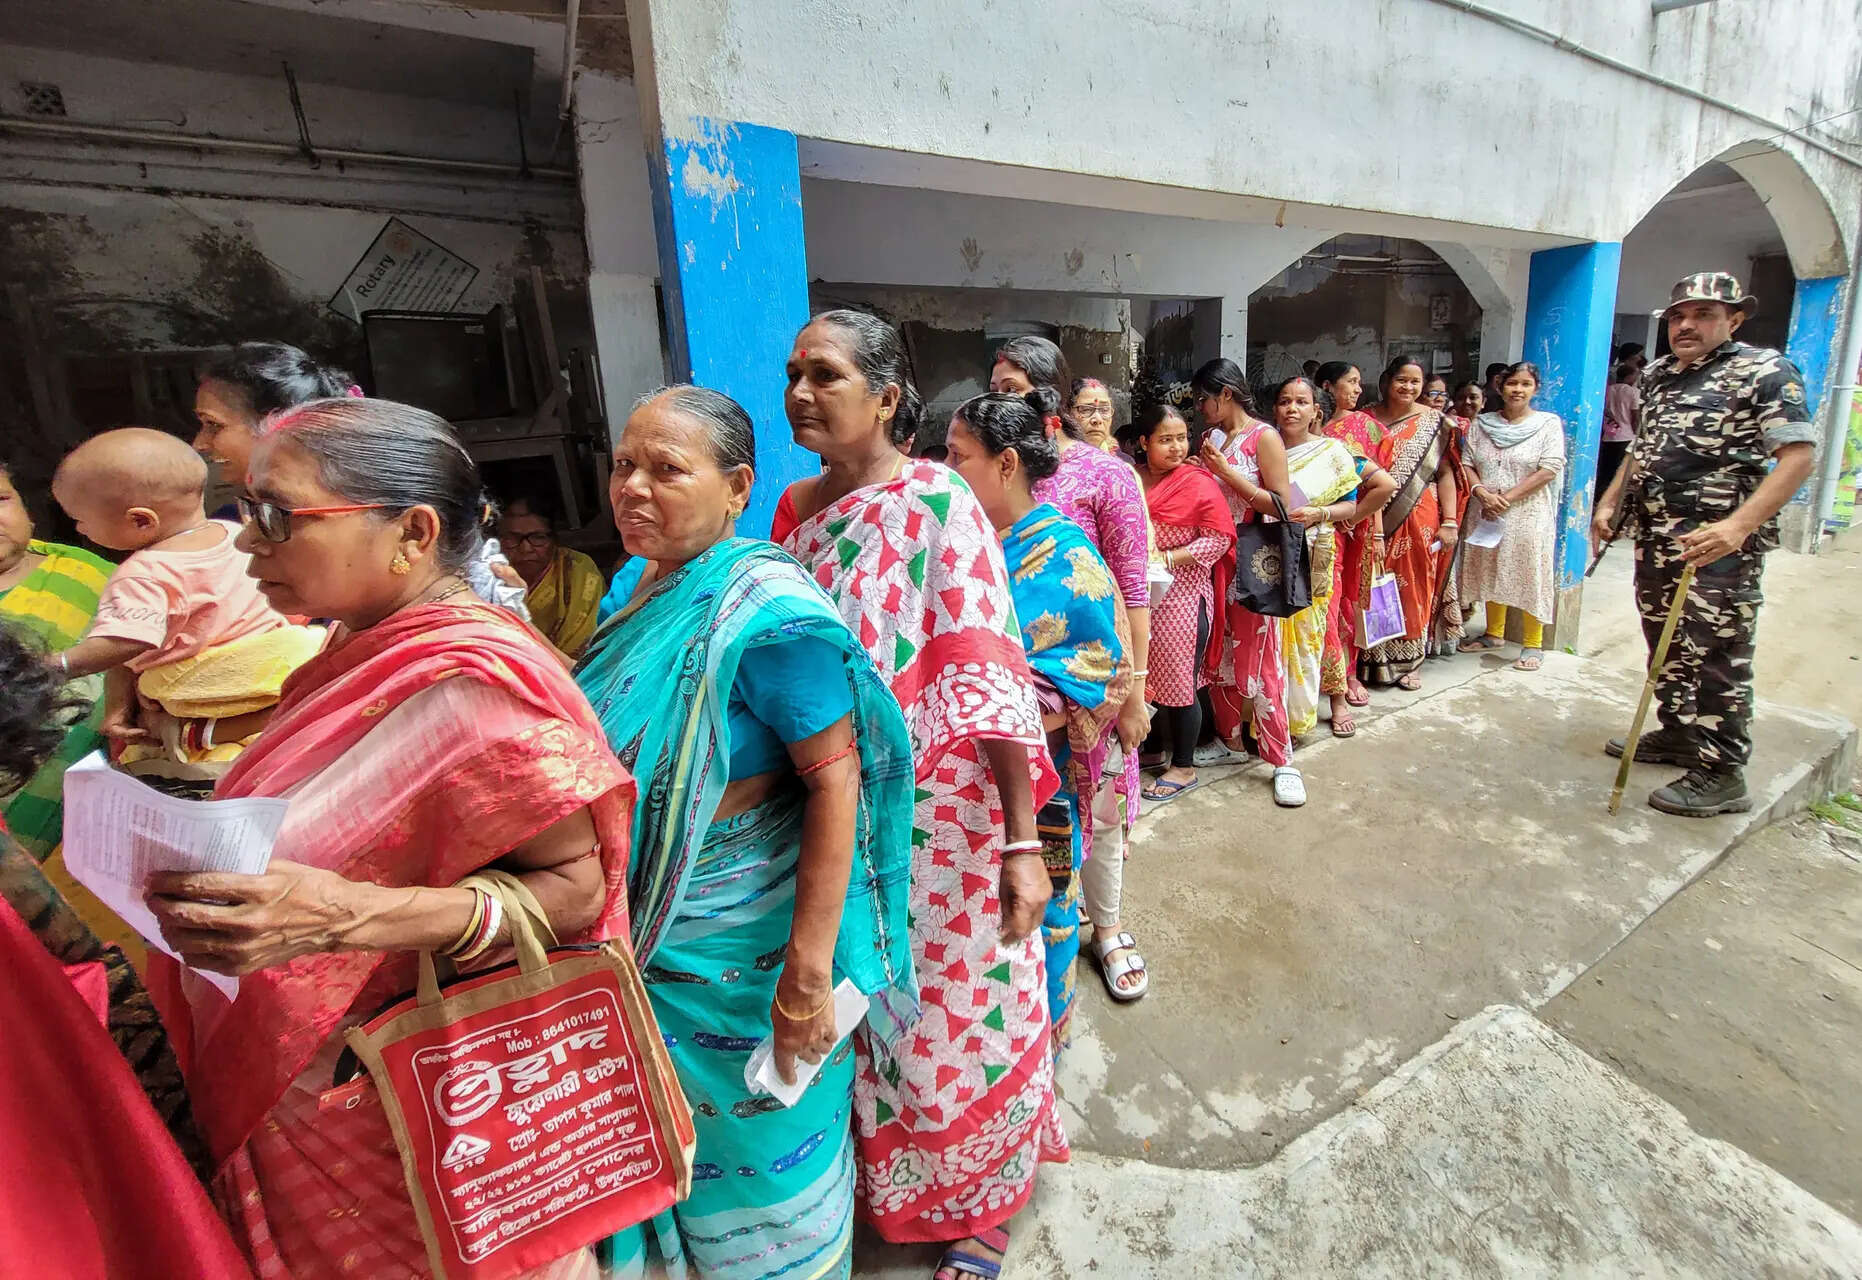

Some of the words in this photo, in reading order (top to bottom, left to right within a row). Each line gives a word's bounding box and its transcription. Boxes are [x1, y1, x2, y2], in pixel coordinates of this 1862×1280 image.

[356, 254, 396, 298] Rotary
[506, 1037, 533, 1054] Mob
[541, 1006, 610, 1041] 8641017491
[583, 1055, 628, 1084] হাউস
[542, 1107, 578, 1133] তাপস
[578, 1089, 613, 1120] কুমার
[613, 1083, 636, 1098] পাল
